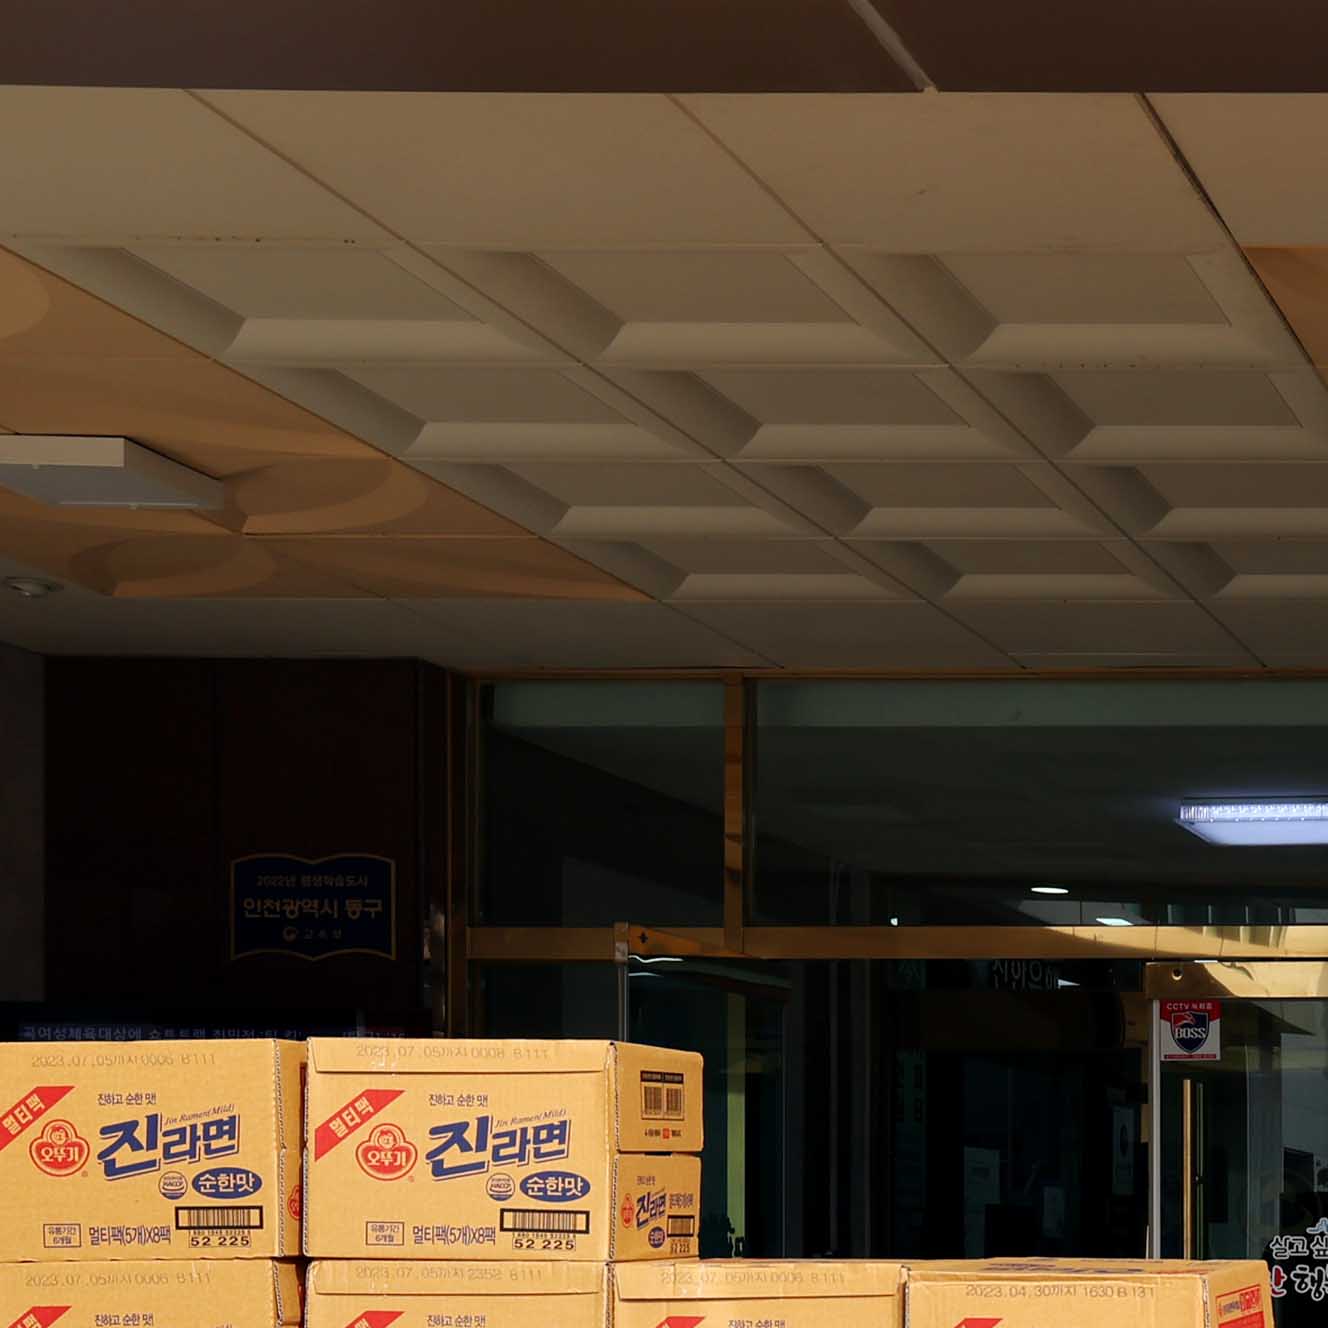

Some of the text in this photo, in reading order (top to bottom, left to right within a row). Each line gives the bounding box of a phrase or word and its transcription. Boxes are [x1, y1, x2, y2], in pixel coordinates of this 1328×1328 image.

[242, 897, 384, 920] 인천광역시 동구
[1175, 1027, 1206, 1039] BOSS
[2, 1093, 46, 1132] 멀티팩
[41, 1145, 80, 1163] 오뚜기
[97, 1111, 242, 1182] 진라면
[425, 1114, 574, 1183] 진라면
[197, 1173, 256, 1193] 순한맛
[190, 1235, 250, 1247] 52 225
[1270, 1236, 1309, 1259] 살고
